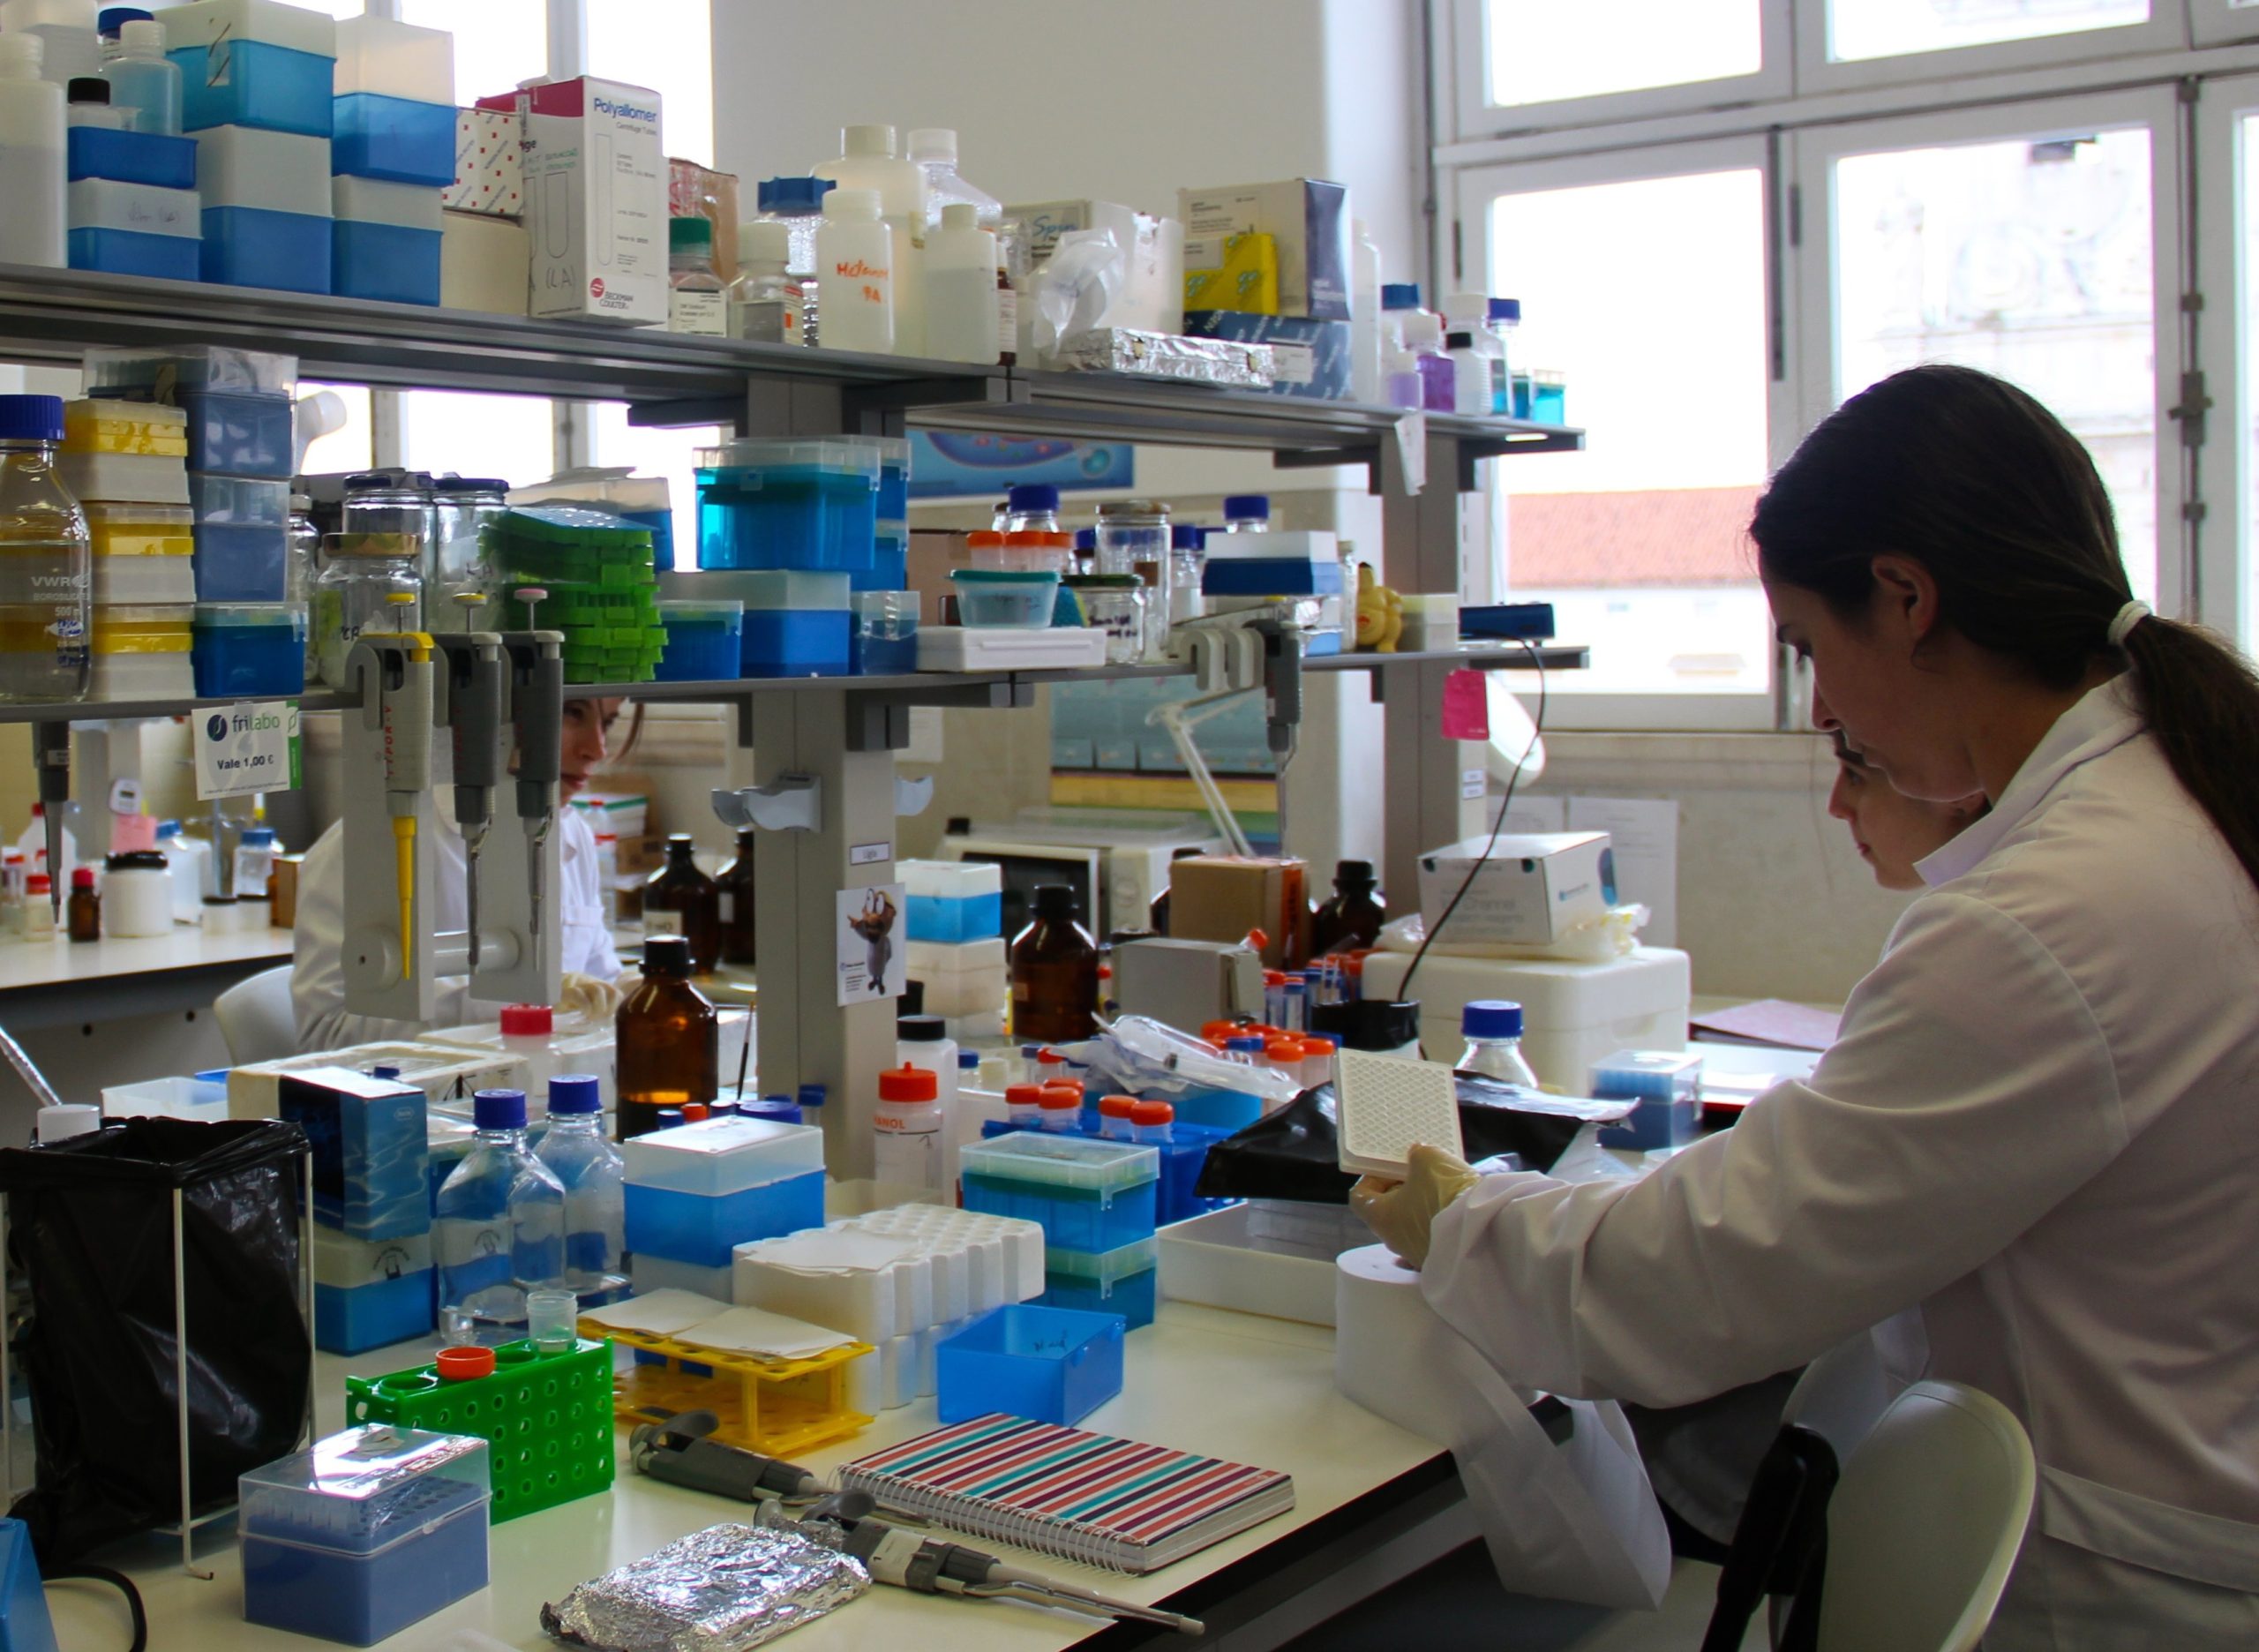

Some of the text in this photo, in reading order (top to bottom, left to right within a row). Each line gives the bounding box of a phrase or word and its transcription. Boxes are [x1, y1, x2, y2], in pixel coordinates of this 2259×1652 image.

[594, 97, 657, 122] Polyallomer
[31, 576, 71, 587] VWR
[232, 713, 281, 732] frilabo
[217, 755, 274, 770] Vale 1,00 €
[874, 1115, 905, 1130] ANOL
